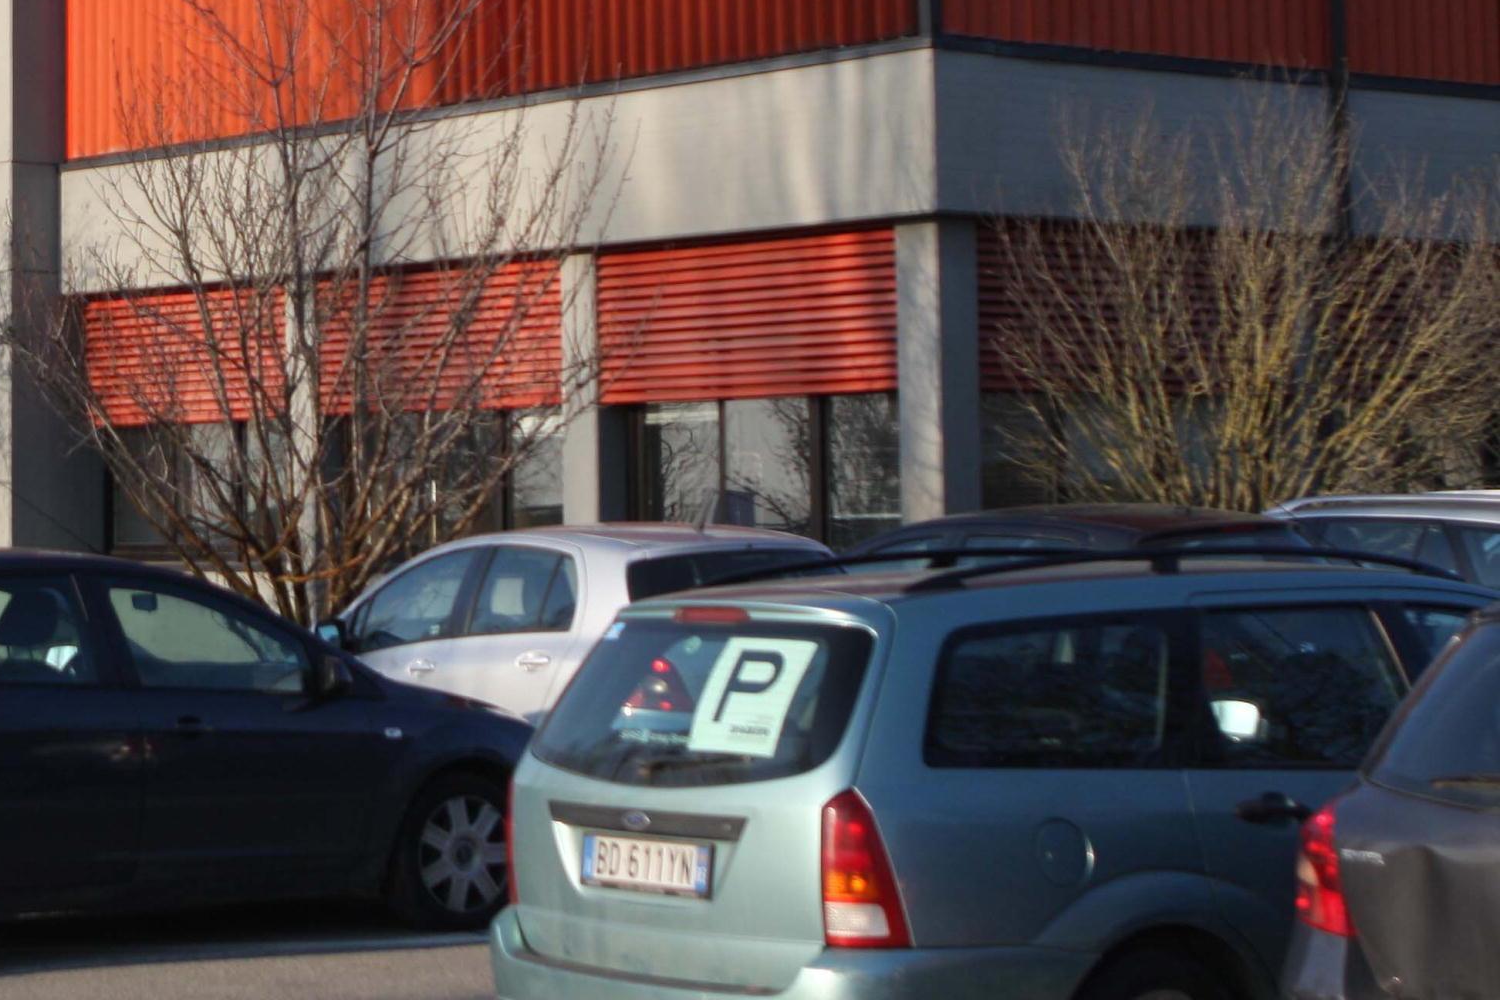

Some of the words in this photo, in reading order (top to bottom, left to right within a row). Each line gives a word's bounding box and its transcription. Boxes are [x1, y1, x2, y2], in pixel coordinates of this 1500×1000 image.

[712, 650, 783, 722] P
[596, 840, 621, 876] BD
[627, 842, 693, 885] 611YN
